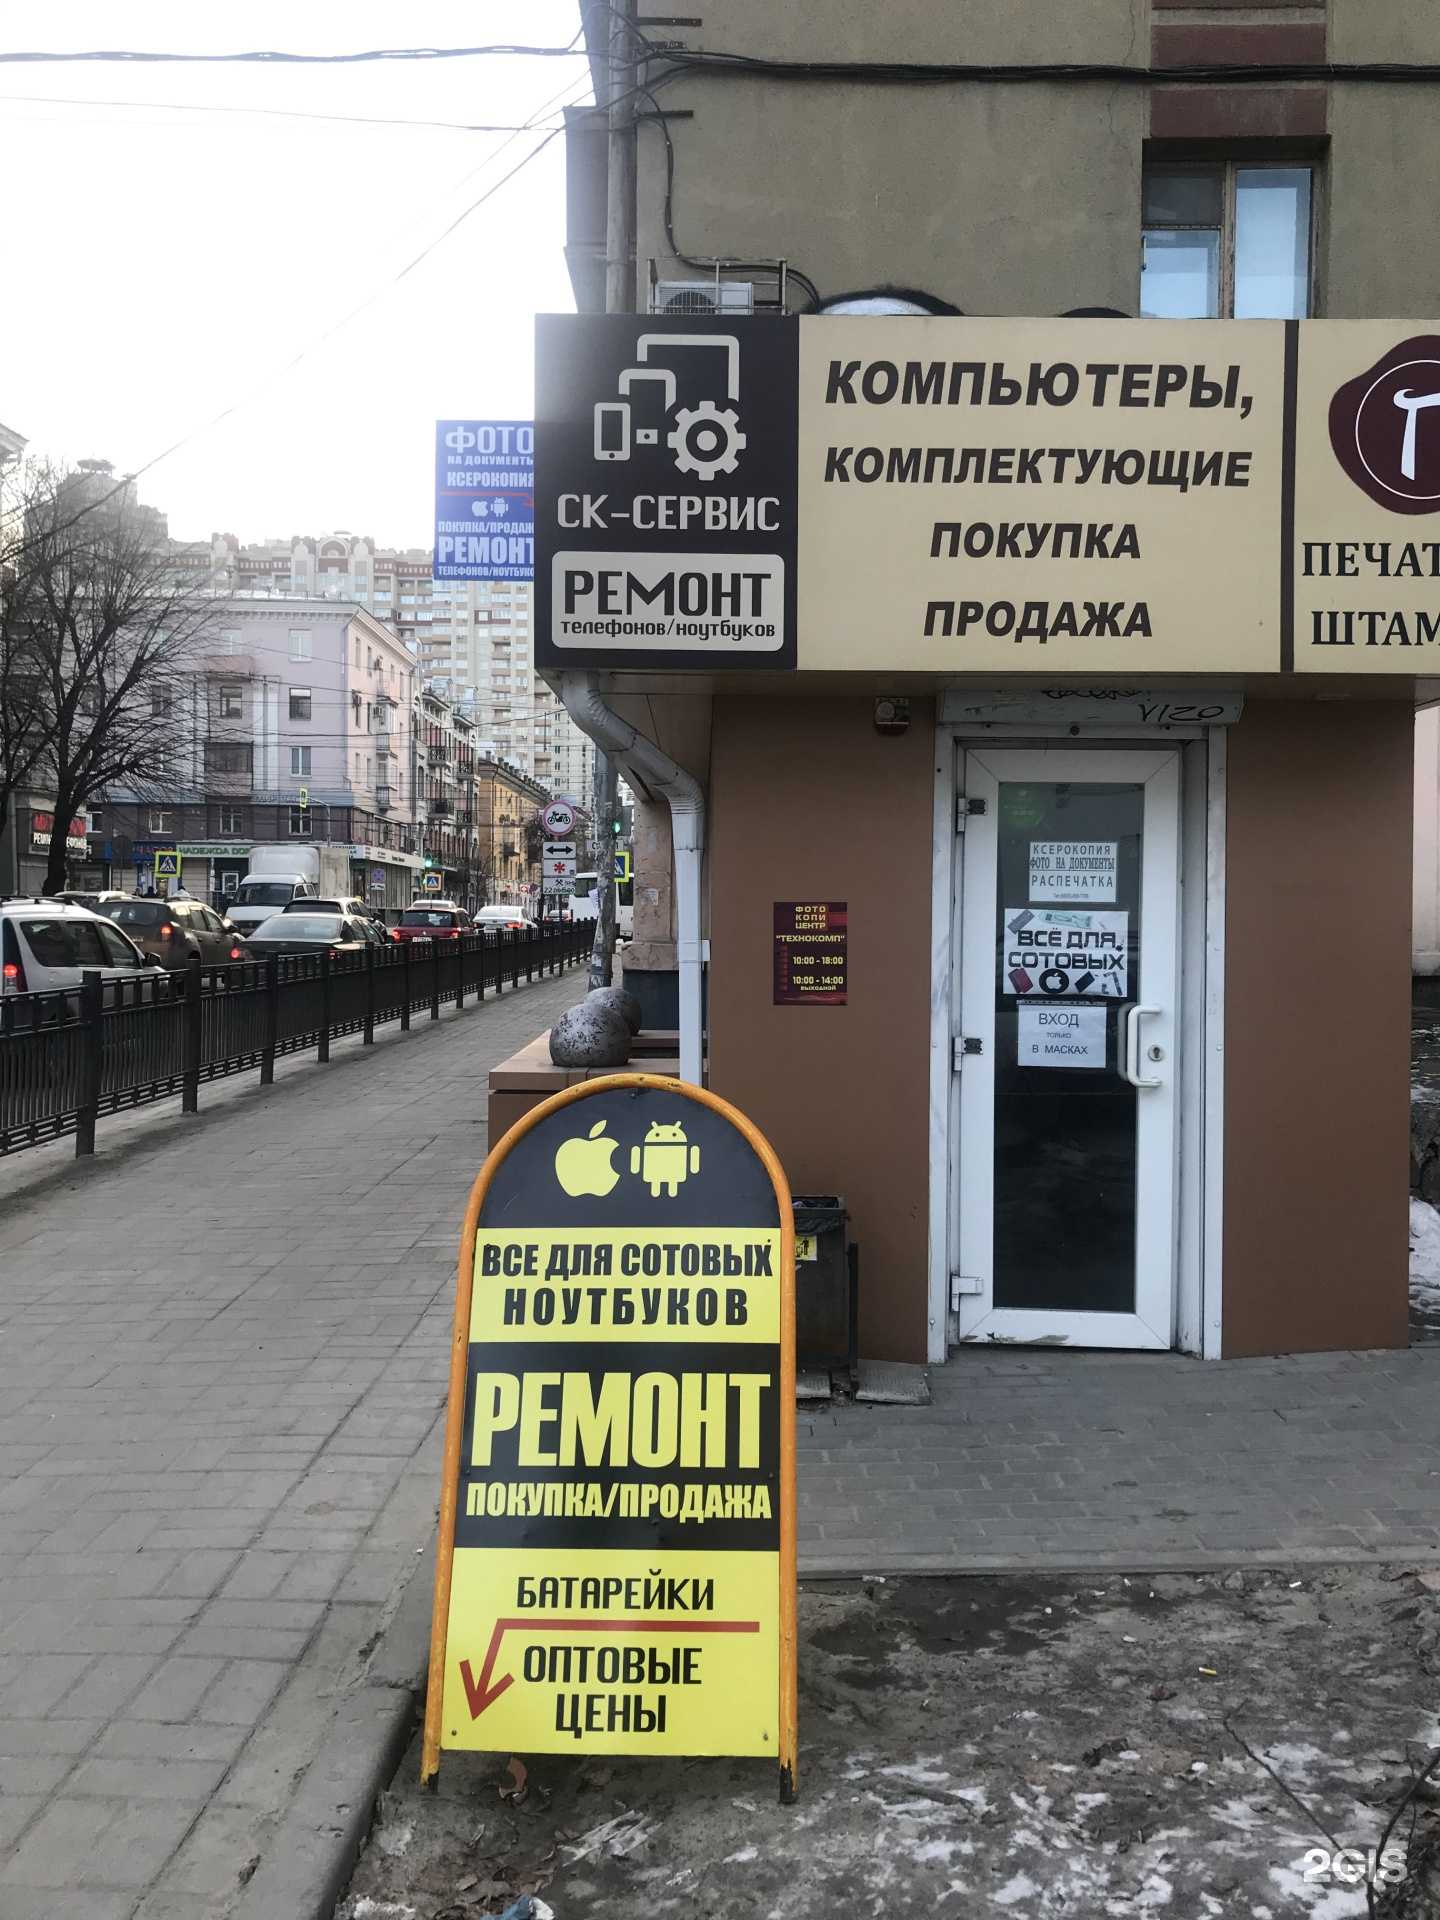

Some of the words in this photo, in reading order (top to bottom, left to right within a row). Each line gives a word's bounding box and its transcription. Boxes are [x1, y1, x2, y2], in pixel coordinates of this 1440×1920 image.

[825, 360, 1253, 420] КОМПЬЮТЕРЫ,
[445, 426, 534, 454] ФОТО
[447, 455, 462, 465] НА
[824, 446, 1253, 493] КОМПЛЕКТУЮЩИЕ
[557, 494, 780, 531] СК-СЕРВИС
[438, 521, 534, 535] ПОКУПКА/ПРОДАЖ
[930, 522, 1141, 559] ПОКУПКА
[438, 535, 534, 564] РЕМОНТ
[438, 566, 534, 577] ТЕЛЕФОНОВ/НОУТБУКО
[564, 570, 772, 617] РЕМОНТ
[560, 618, 776, 641] телефонов/ноутбуков
[923, 600, 1153, 643] ПРОДАЖА
[1030, 856, 1050, 869] ФОТО
[1055, 857, 1066, 869] НА
[1069, 857, 1115, 870] ДОКУМЕНТЫ
[1033, 844, 1111, 855] КСЕРОКОПИЯ
[1031, 875, 1113, 887] РАСПЕЧАТКА
[1017, 928, 1062, 947] ВСЁ
[1066, 931, 1116, 950] ДЛЯ
[792, 956, 814, 965] 10:00
[822, 956, 844, 965] 18:00
[1008, 951, 1125, 970] СОТОВЫХ
[792, 976, 814, 985] 10:00
[822, 976, 844, 985] 14:00
[1038, 1013, 1080, 1028] ВХОД
[1032, 1044, 1039, 1053] В
[1044, 1045, 1088, 1055] МАСКАХ
[481, 1244, 539, 1277] ВСЕ
[545, 1244, 612, 1281] ДЛЯ
[620, 1244, 773, 1278] СОТОВЫХ
[503, 1287, 748, 1326] НОУТБУКОВ
[470, 1371, 771, 1469] РЕМОНТ
[466, 1482, 772, 1524] ПОКУПКА/ПРОДАЖА
[516, 1568, 715, 1611] БАТАРЕЙКИ
[523, 1645, 703, 1685] ОПТОВЫЕ
[555, 1693, 667, 1739] ЦЕНЫ
